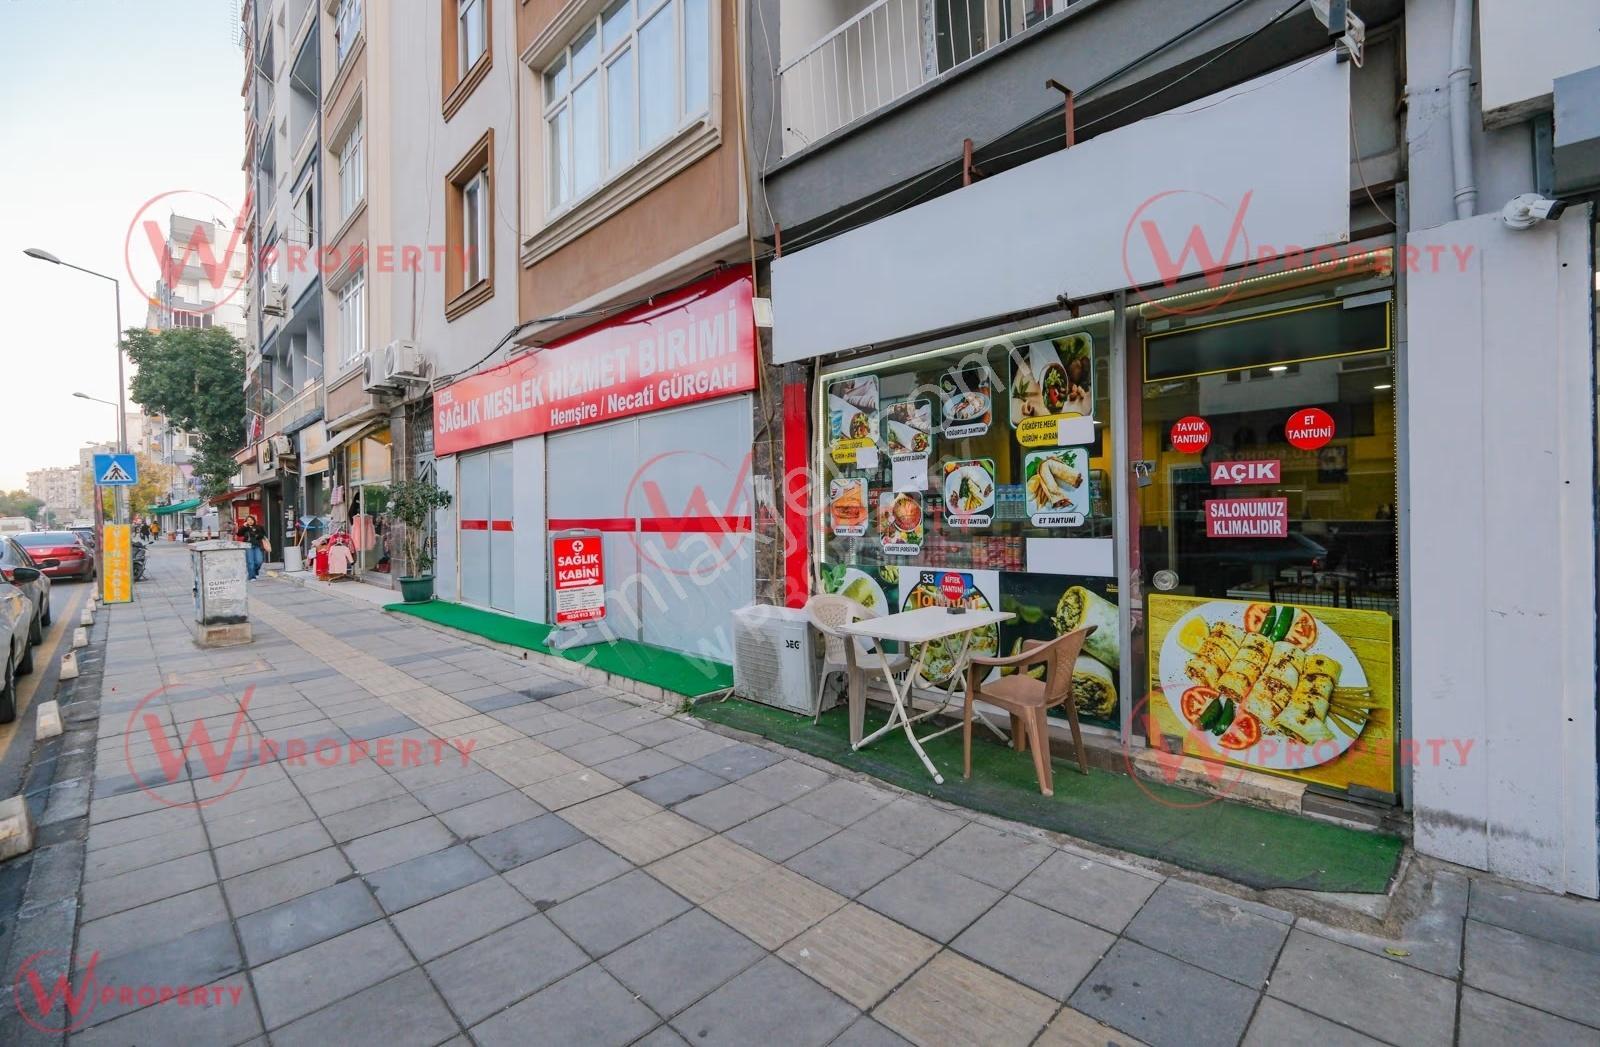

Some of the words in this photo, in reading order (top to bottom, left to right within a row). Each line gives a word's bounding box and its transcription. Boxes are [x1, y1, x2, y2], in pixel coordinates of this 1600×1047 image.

[439, 398, 480, 434] SAĞLIK
[483, 378, 544, 421] MESLEK
[638, 297, 738, 378] BİRİMİ
[551, 401, 597, 425] Hemşire
[607, 388, 654, 413] Necati
[658, 363, 737, 402] GÜRGAH
[1043, 420, 1056, 428] MEGA
[1176, 422, 1204, 432] TAVUK
[1304, 415, 1314, 425] ET
[1173, 433, 1208, 444] TANTUNİ
[1288, 426, 1331, 440] TANTUNİ
[1213, 463, 1276, 484] AÇIK
[1210, 501, 1284, 518] SALONUMUZ
[1048, 515, 1076, 524] TANTUNİ
[558, 552, 599, 566] SAĞLIK
[559, 565, 599, 580] KABİNİ
[922, 574, 934, 584] 33
